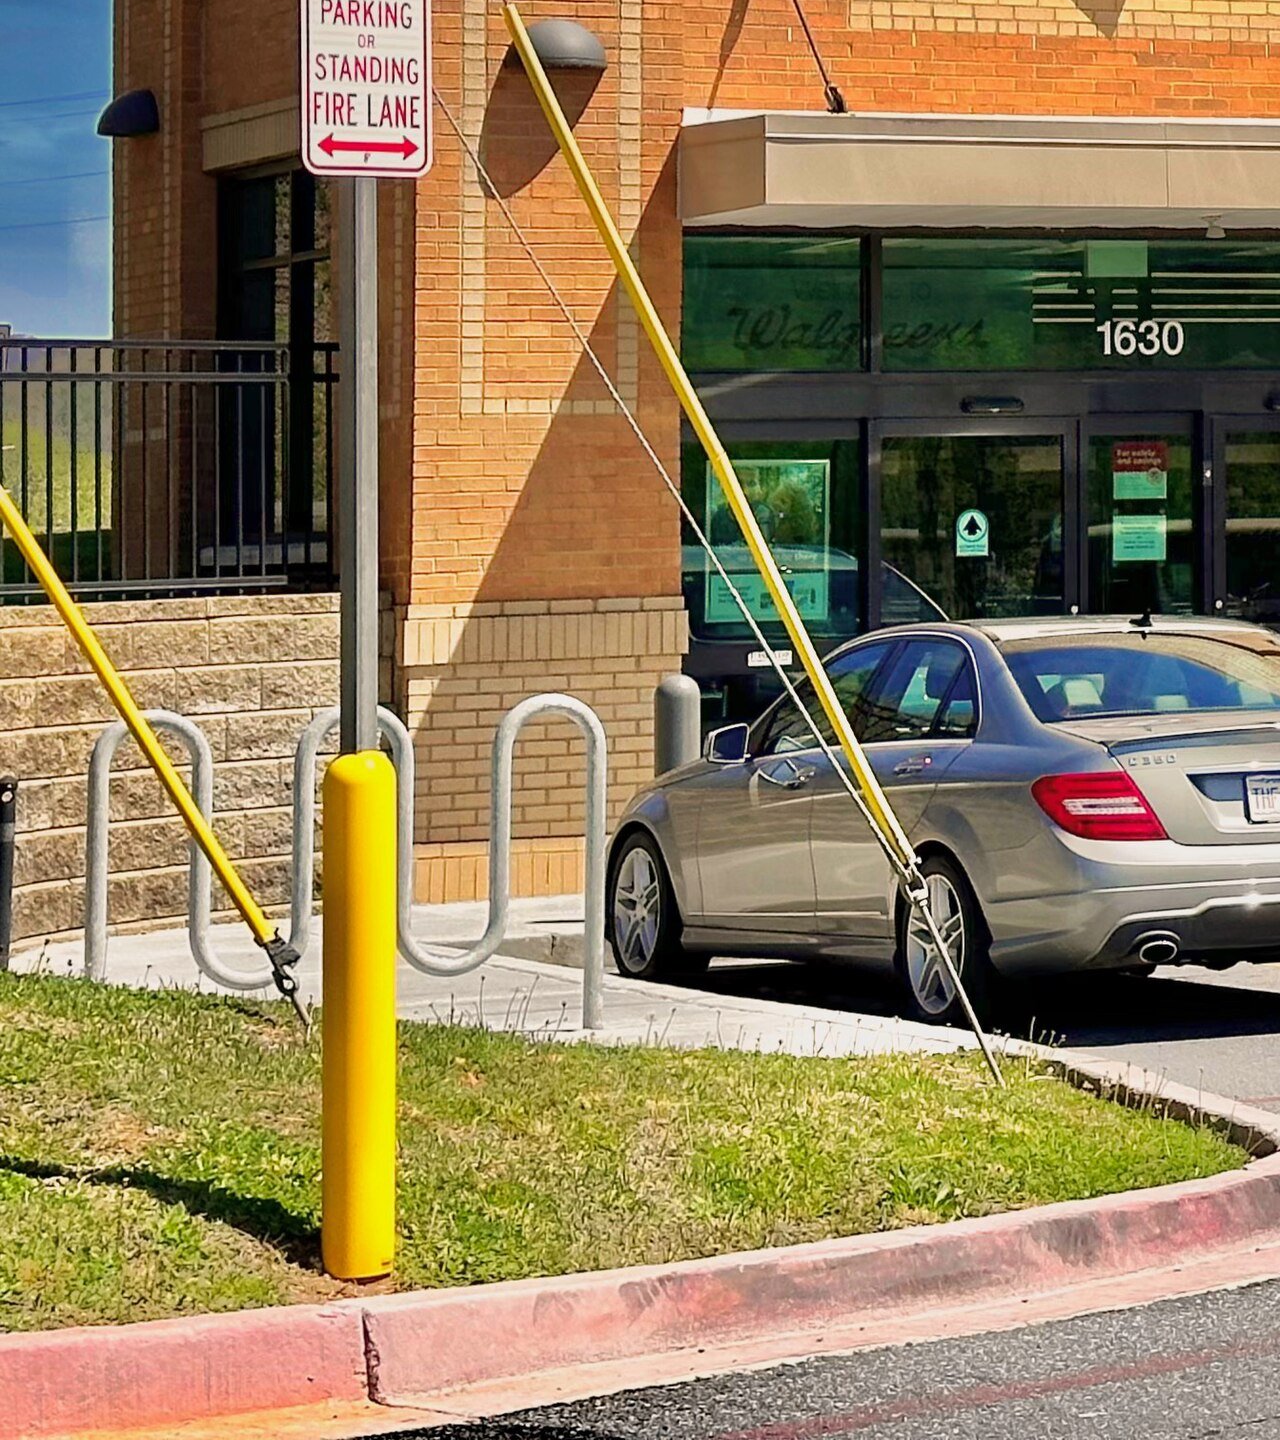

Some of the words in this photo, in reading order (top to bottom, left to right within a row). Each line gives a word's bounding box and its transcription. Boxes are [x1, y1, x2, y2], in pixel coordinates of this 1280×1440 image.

[357, 34, 375, 49] OR
[314, 54, 419, 85] STANDING
[313, 93, 358, 127] FIRE
[367, 94, 421, 129] LANE
[727, 304, 990, 366] Walgeens
[1096, 319, 1185, 356] 1630
